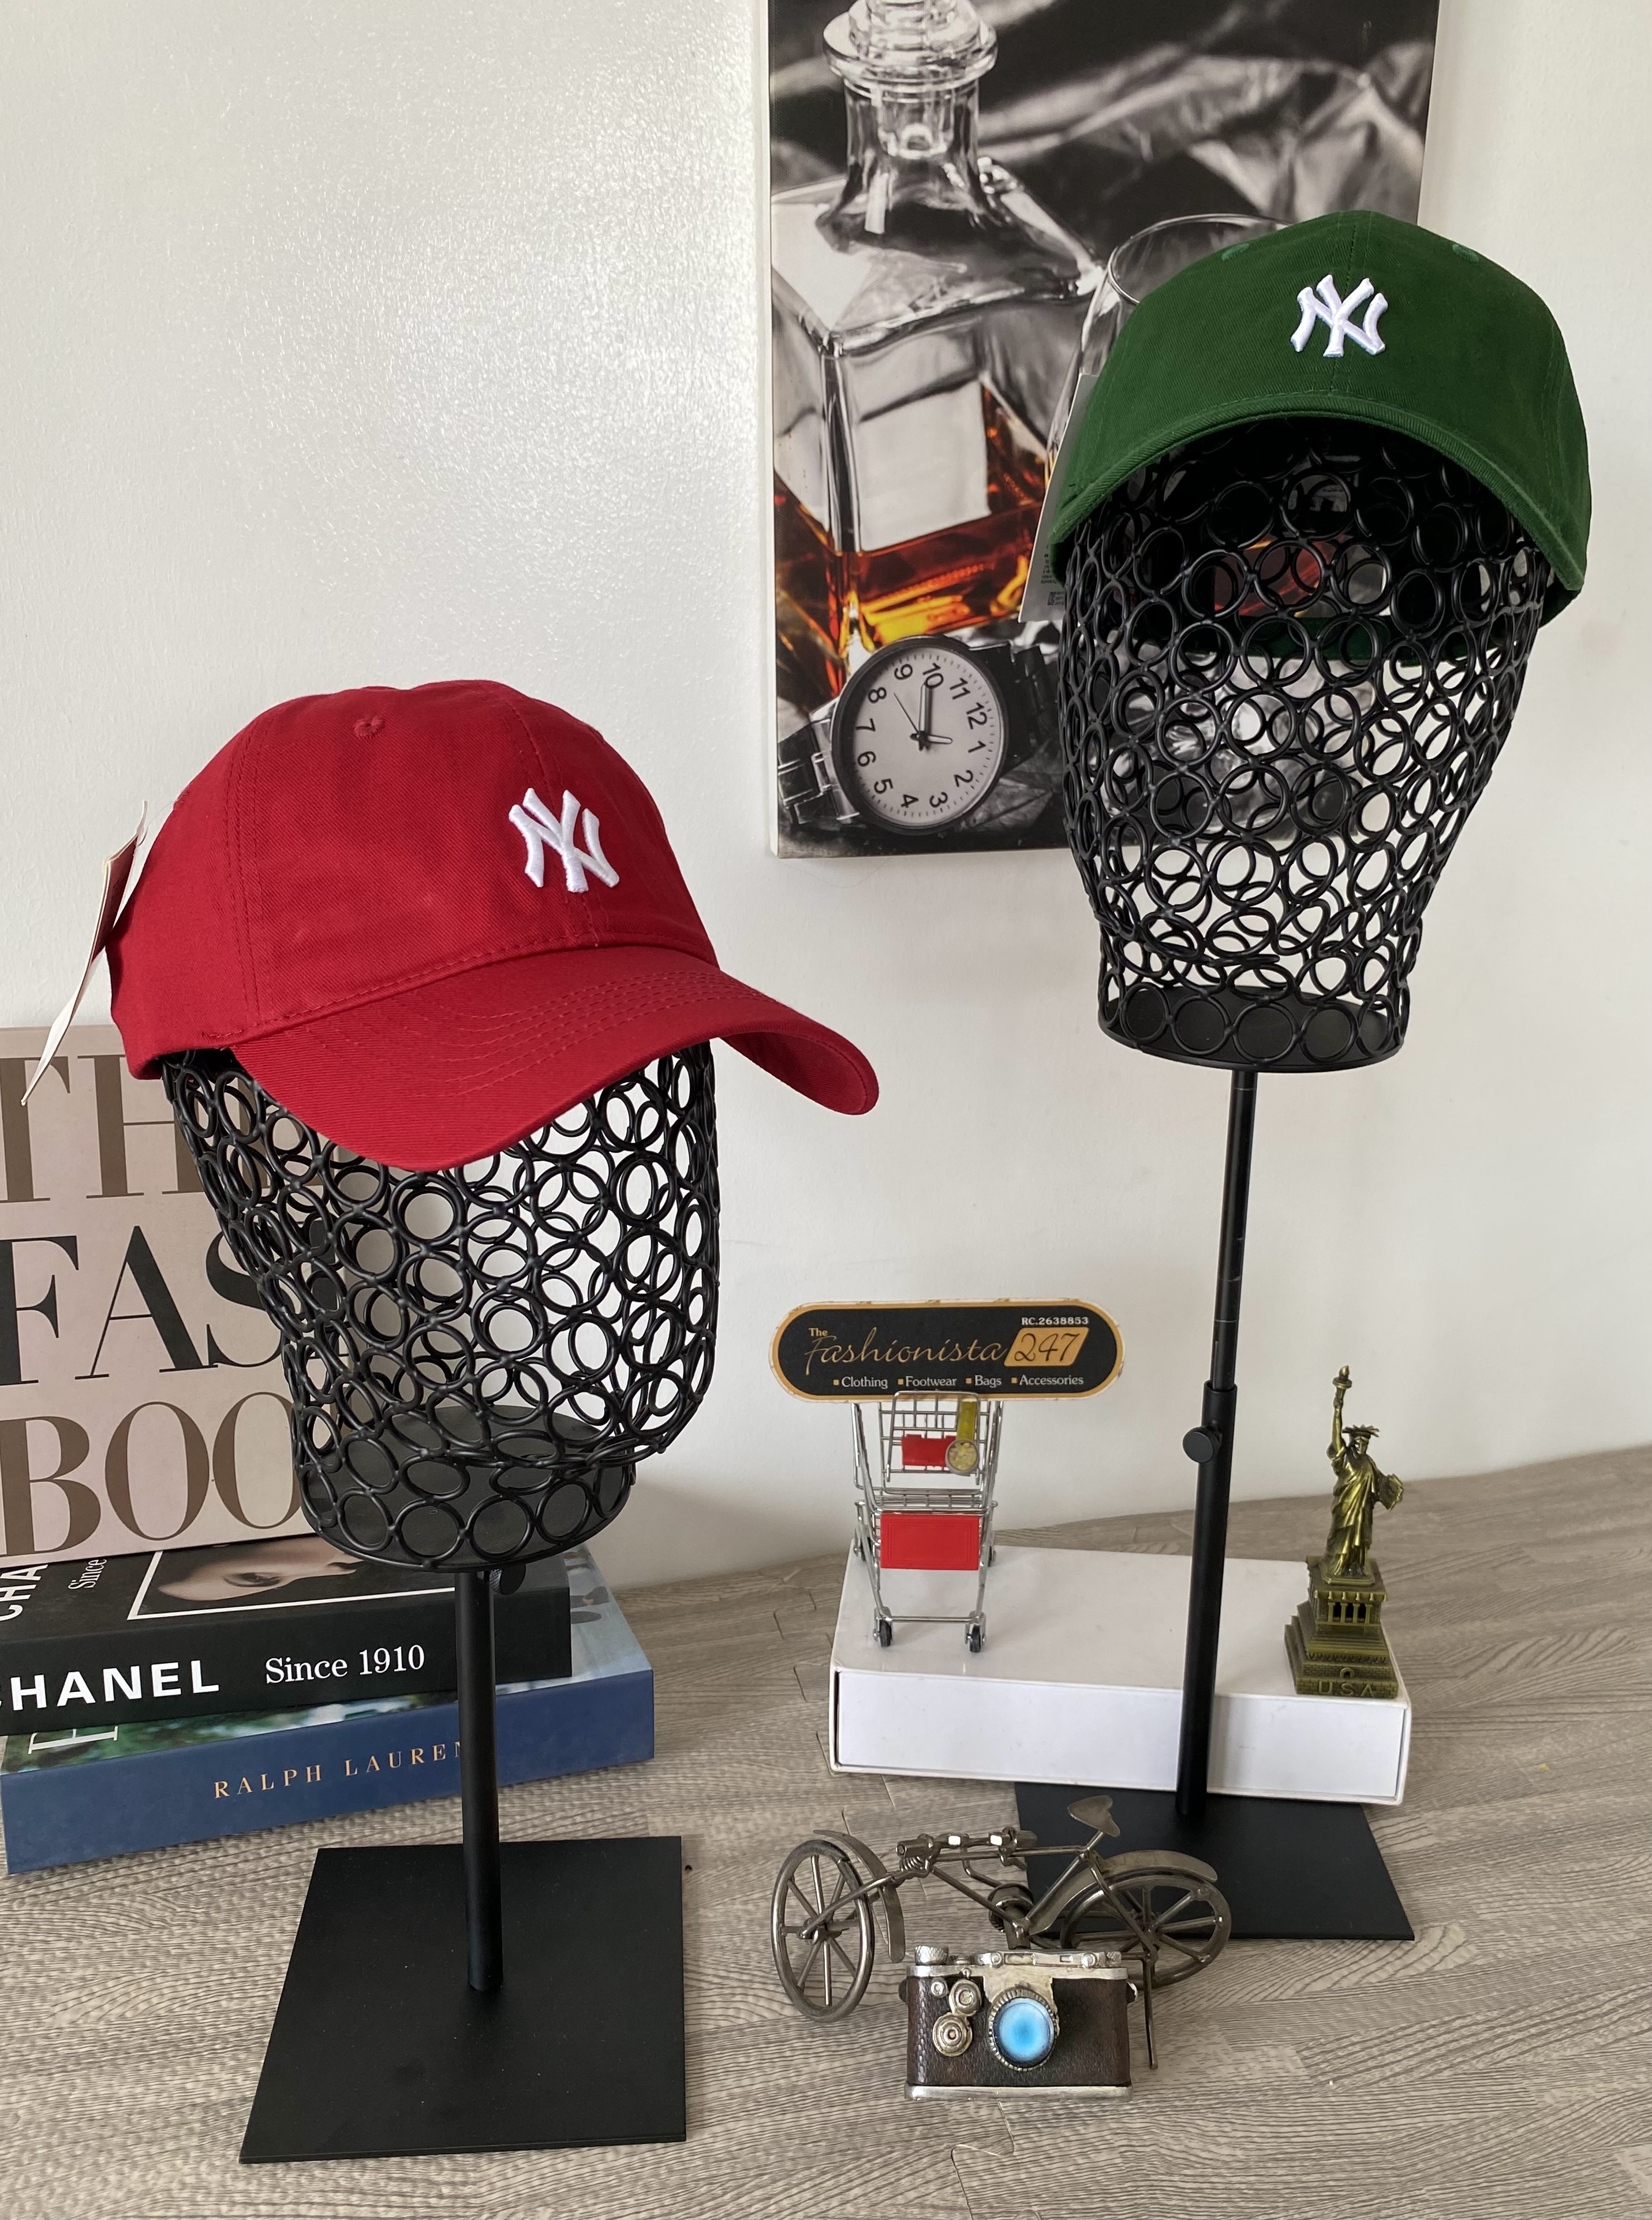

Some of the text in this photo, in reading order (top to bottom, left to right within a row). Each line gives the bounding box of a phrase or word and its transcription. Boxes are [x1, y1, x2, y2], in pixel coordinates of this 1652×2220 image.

[922, 663, 944, 689] 10
[868, 687, 887, 704] 8
[950, 678, 971, 700] 11
[966, 702, 986, 730] 12
[856, 718, 876, 733] 7
[967, 741, 985, 753] 1
[874, 779, 894, 794] 5
[954, 770, 973, 788] 2
[901, 794, 918, 808] 4
[929, 792, 948, 808] 3
[809, 1328, 828, 1336] The
[804, 1327, 1080, 1375] Fashionista 247
[841, 1375, 1084, 1389] Clothing Footwear Bags Accessories
[68, 1559, 107, 1589] Since
[0, 1644, 425, 1711] HANEL Since 1910
[214, 1764, 322, 1799] RALPH
